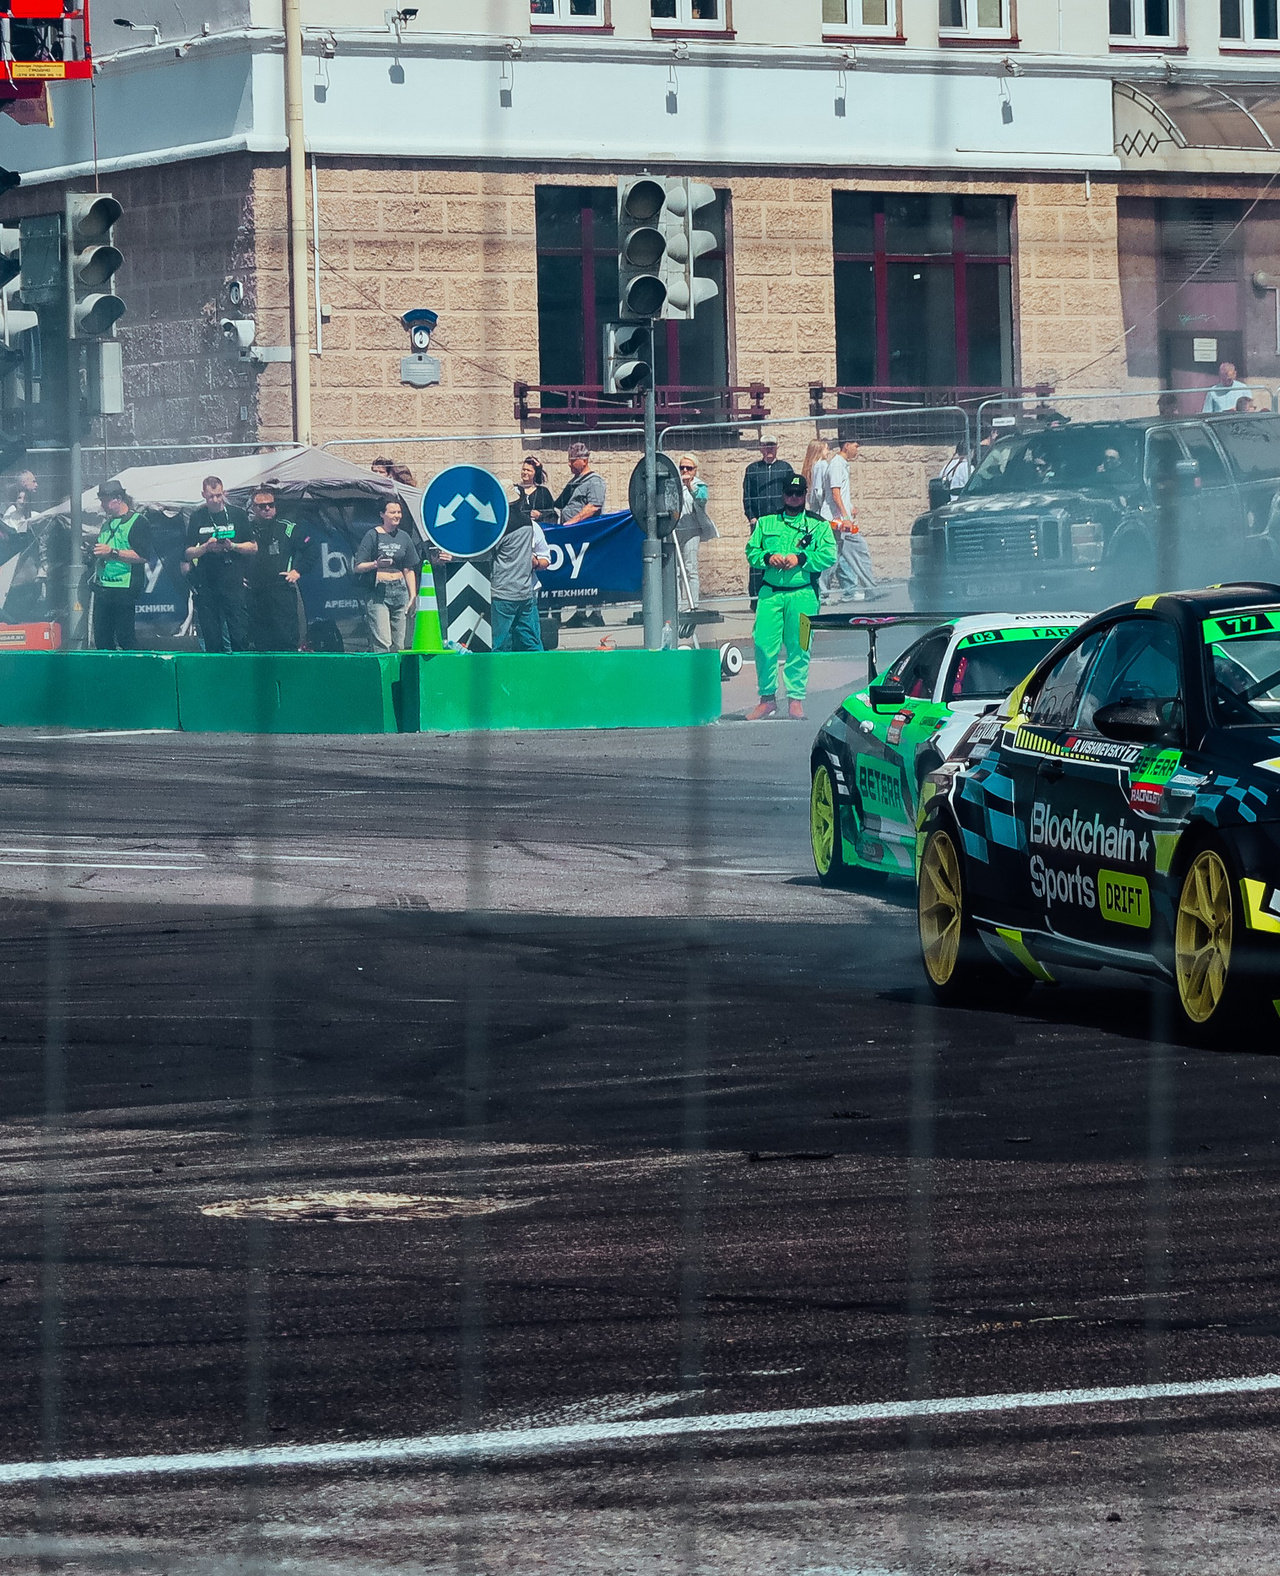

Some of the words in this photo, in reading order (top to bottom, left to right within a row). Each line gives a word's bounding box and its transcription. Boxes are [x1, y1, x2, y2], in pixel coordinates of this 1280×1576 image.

[551, 588, 598, 598] ТЕХНИКИ
[134, 604, 175, 614] ЕХНИКИ
[1225, 616, 1257, 633] 77
[972, 631, 996, 643] 03
[1032, 628, 1076, 638] ГАВ
[1030, 801, 1136, 862] Blockchain
[1030, 854, 1096, 908] Sports
[1105, 882, 1142, 916] DRIFT
